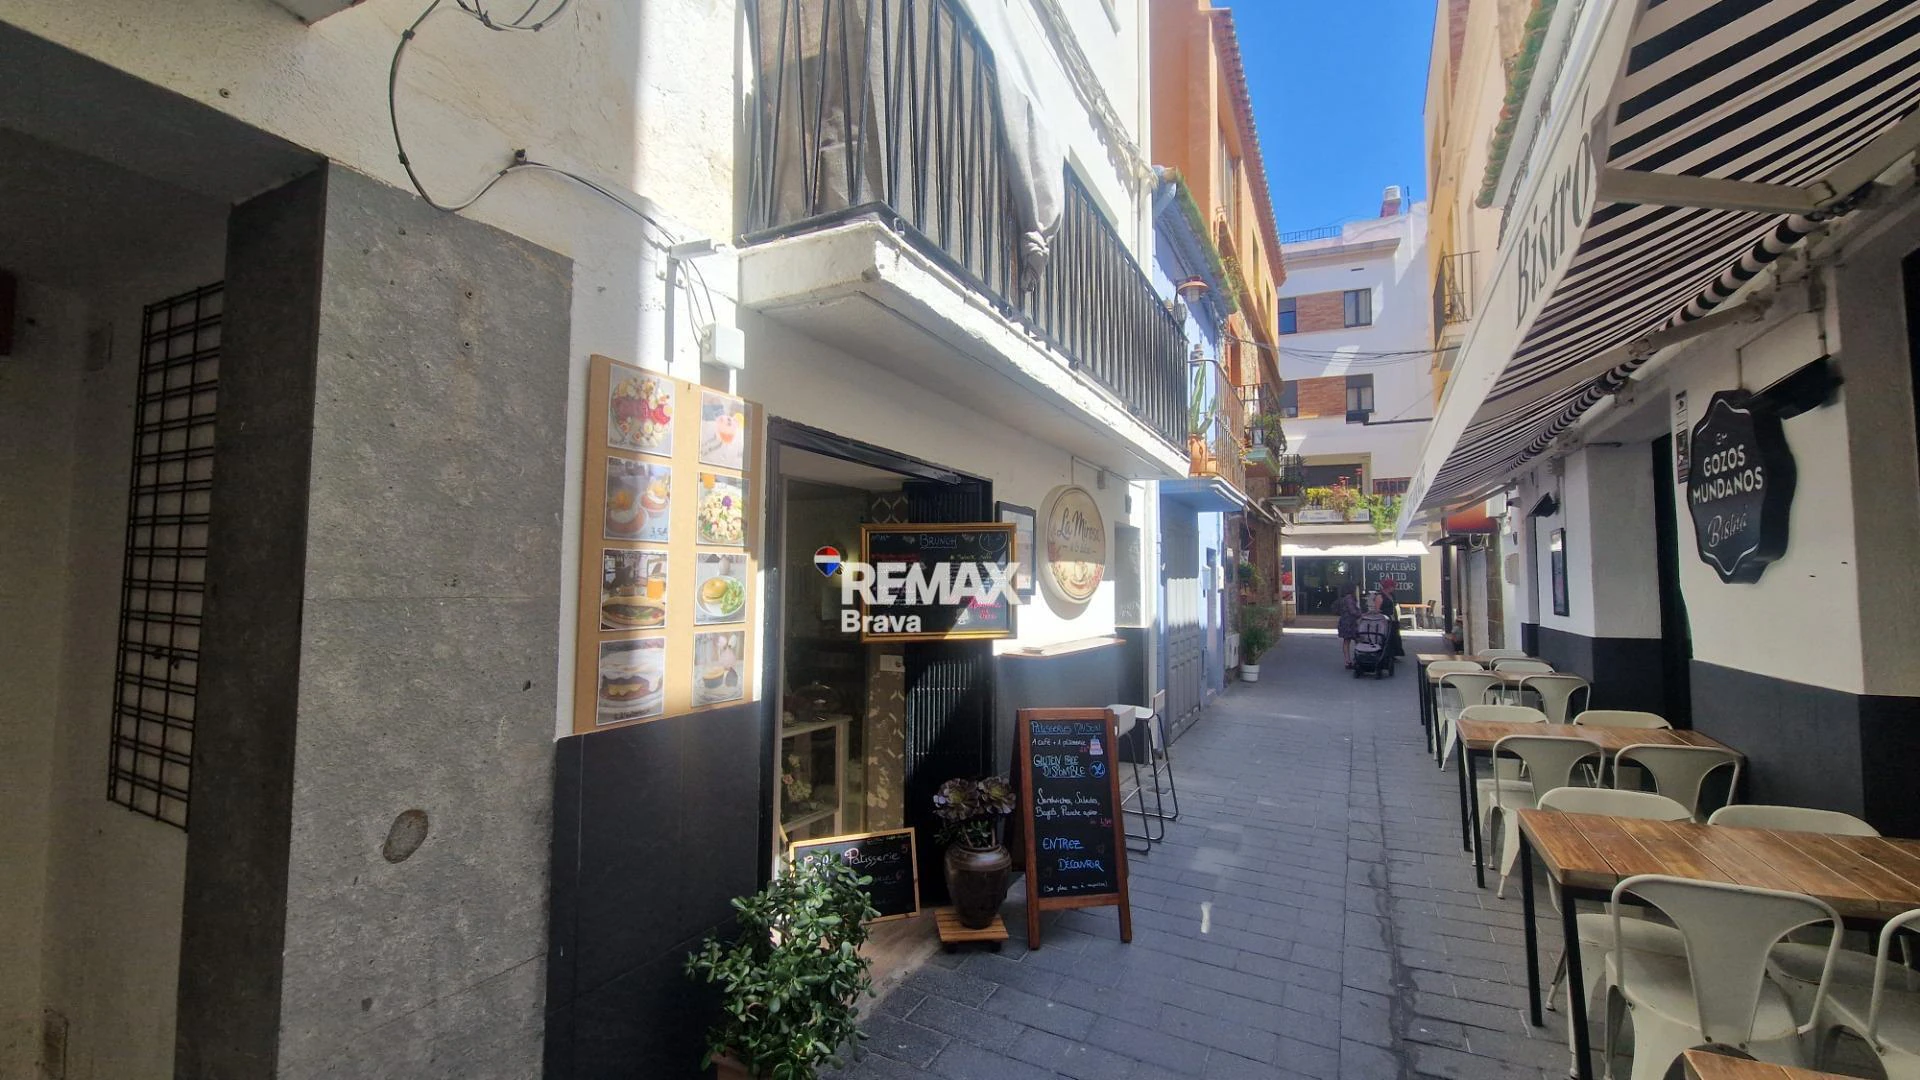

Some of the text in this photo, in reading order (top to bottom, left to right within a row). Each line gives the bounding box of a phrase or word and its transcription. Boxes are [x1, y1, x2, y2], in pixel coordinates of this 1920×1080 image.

[1703, 444, 1745, 477] GOZOS
[1692, 466, 1763, 505] MUNDANOS
[1056, 507, 1072, 540] La
[920, 534, 957, 548] BRUNCH
[1367, 562, 1383, 571] CAN
[1379, 572, 1407, 581] PATIO
[1033, 754, 1061, 768] GLUTEN
